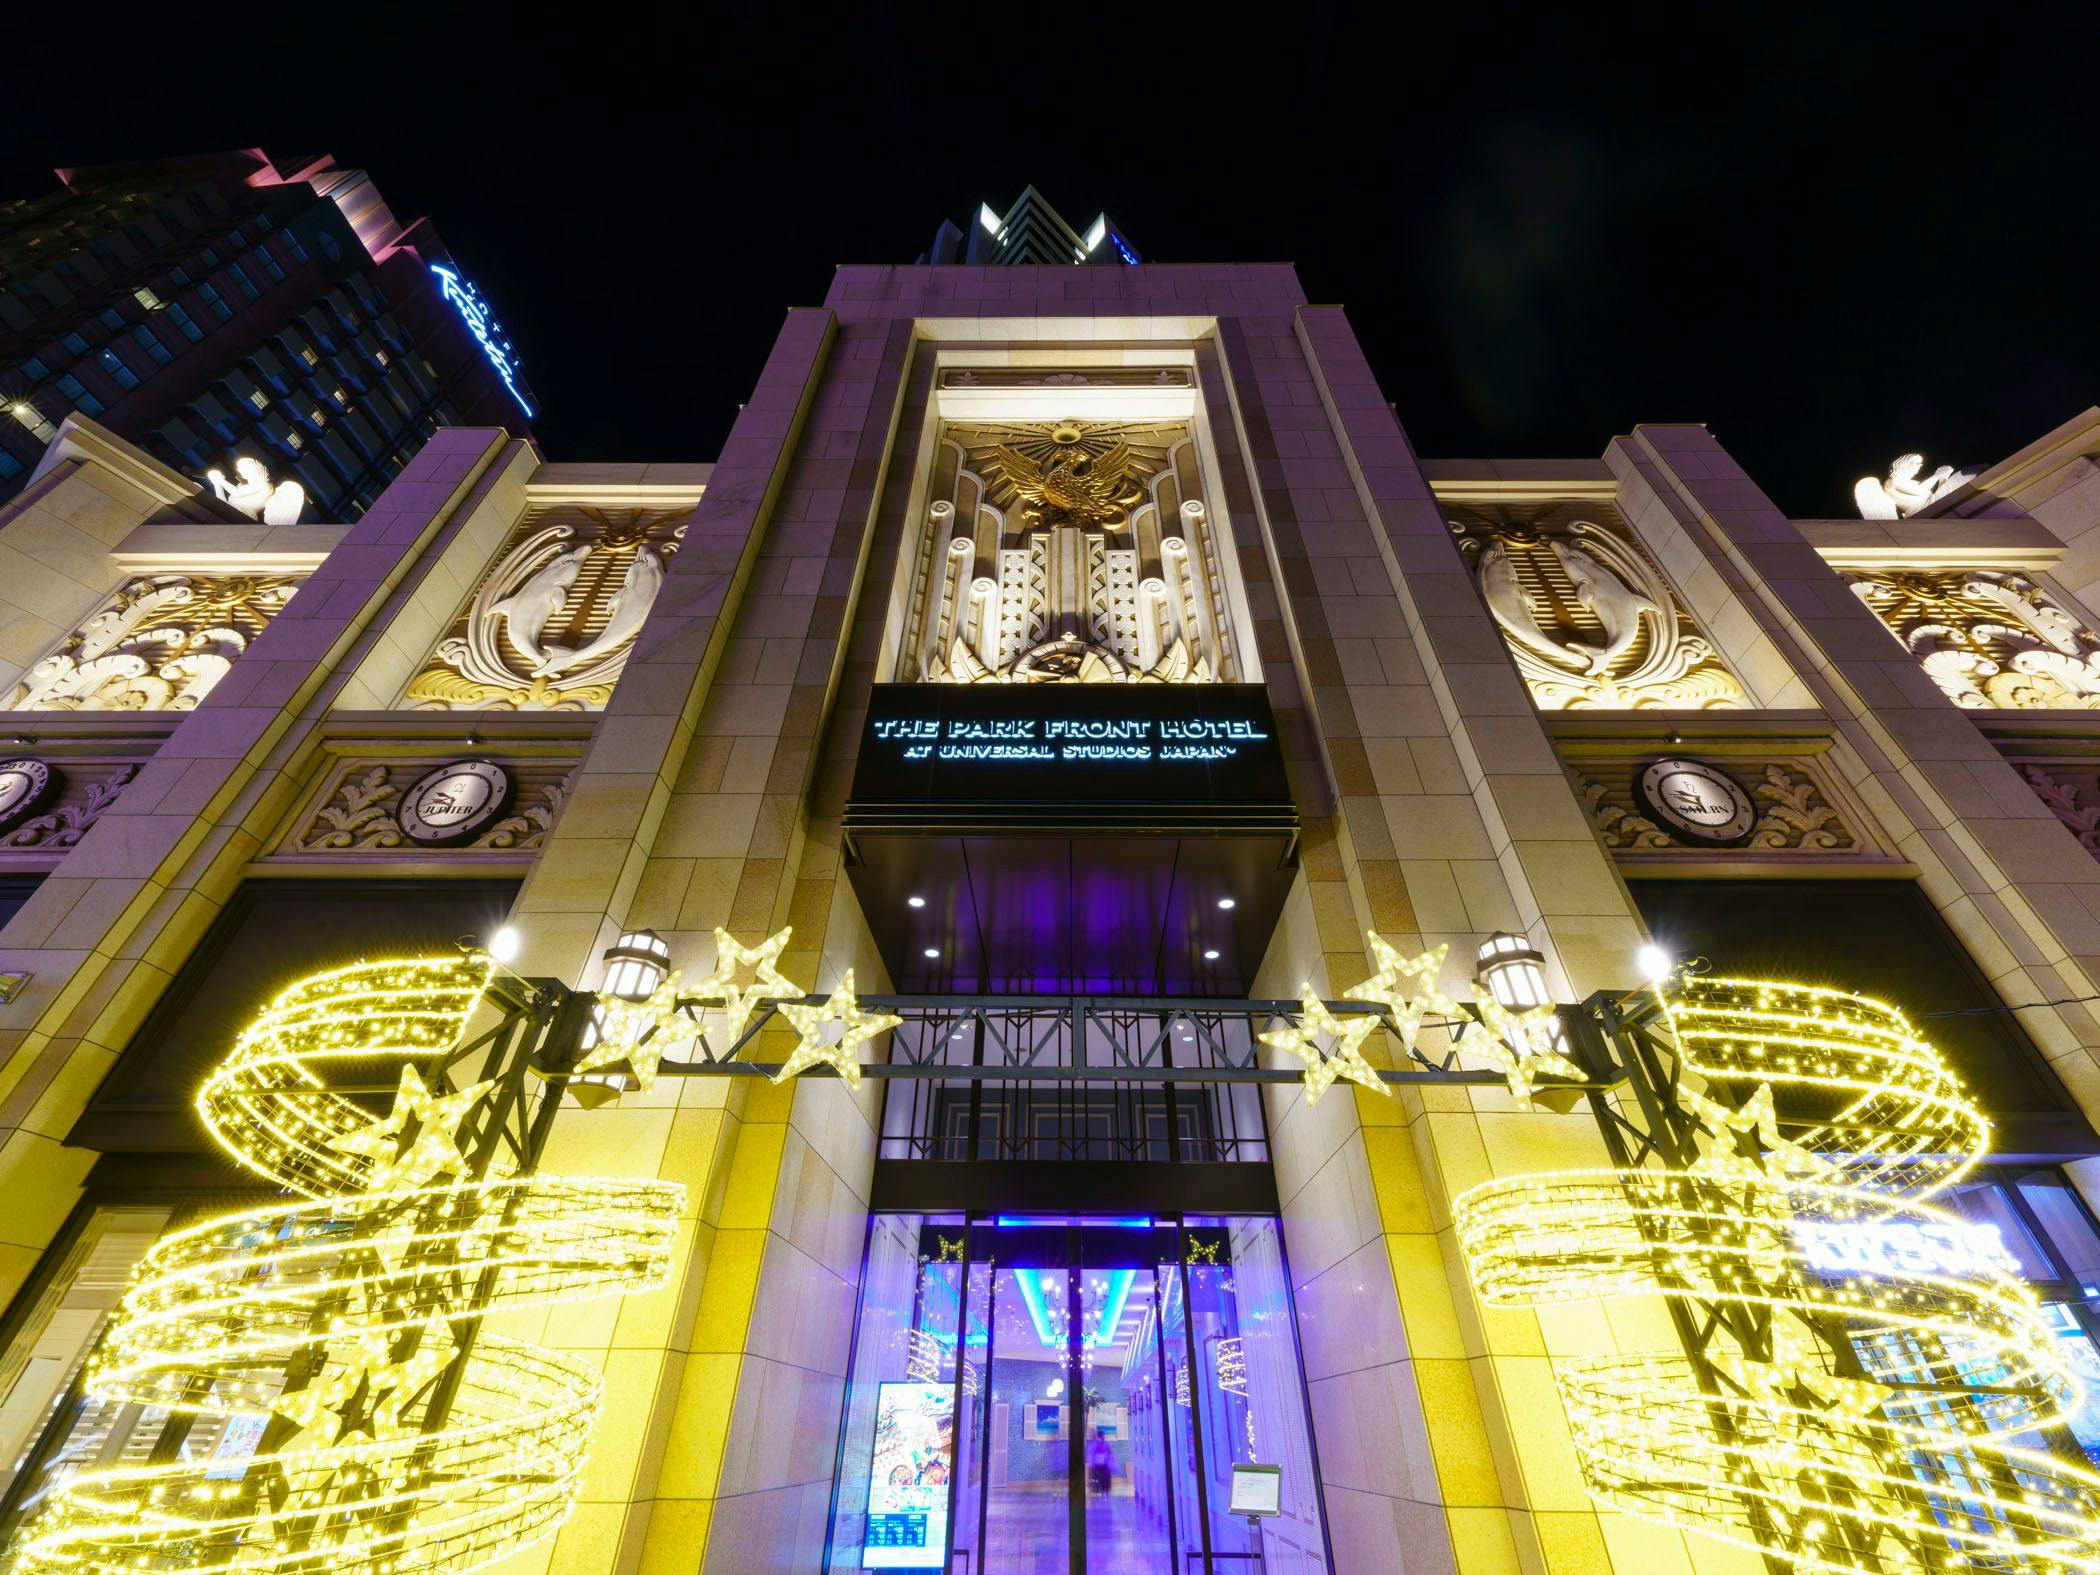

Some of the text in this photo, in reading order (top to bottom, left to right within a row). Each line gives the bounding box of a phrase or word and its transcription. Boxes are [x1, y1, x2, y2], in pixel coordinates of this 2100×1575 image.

[875, 719, 1267, 739] THE PARK FRONT HOTEL
[903, 745, 932, 758] AT
[940, 745, 1055, 759] UNIVERSAL
[1063, 745, 1151, 759] STUDIOS
[423, 805, 474, 814] JUPITER
